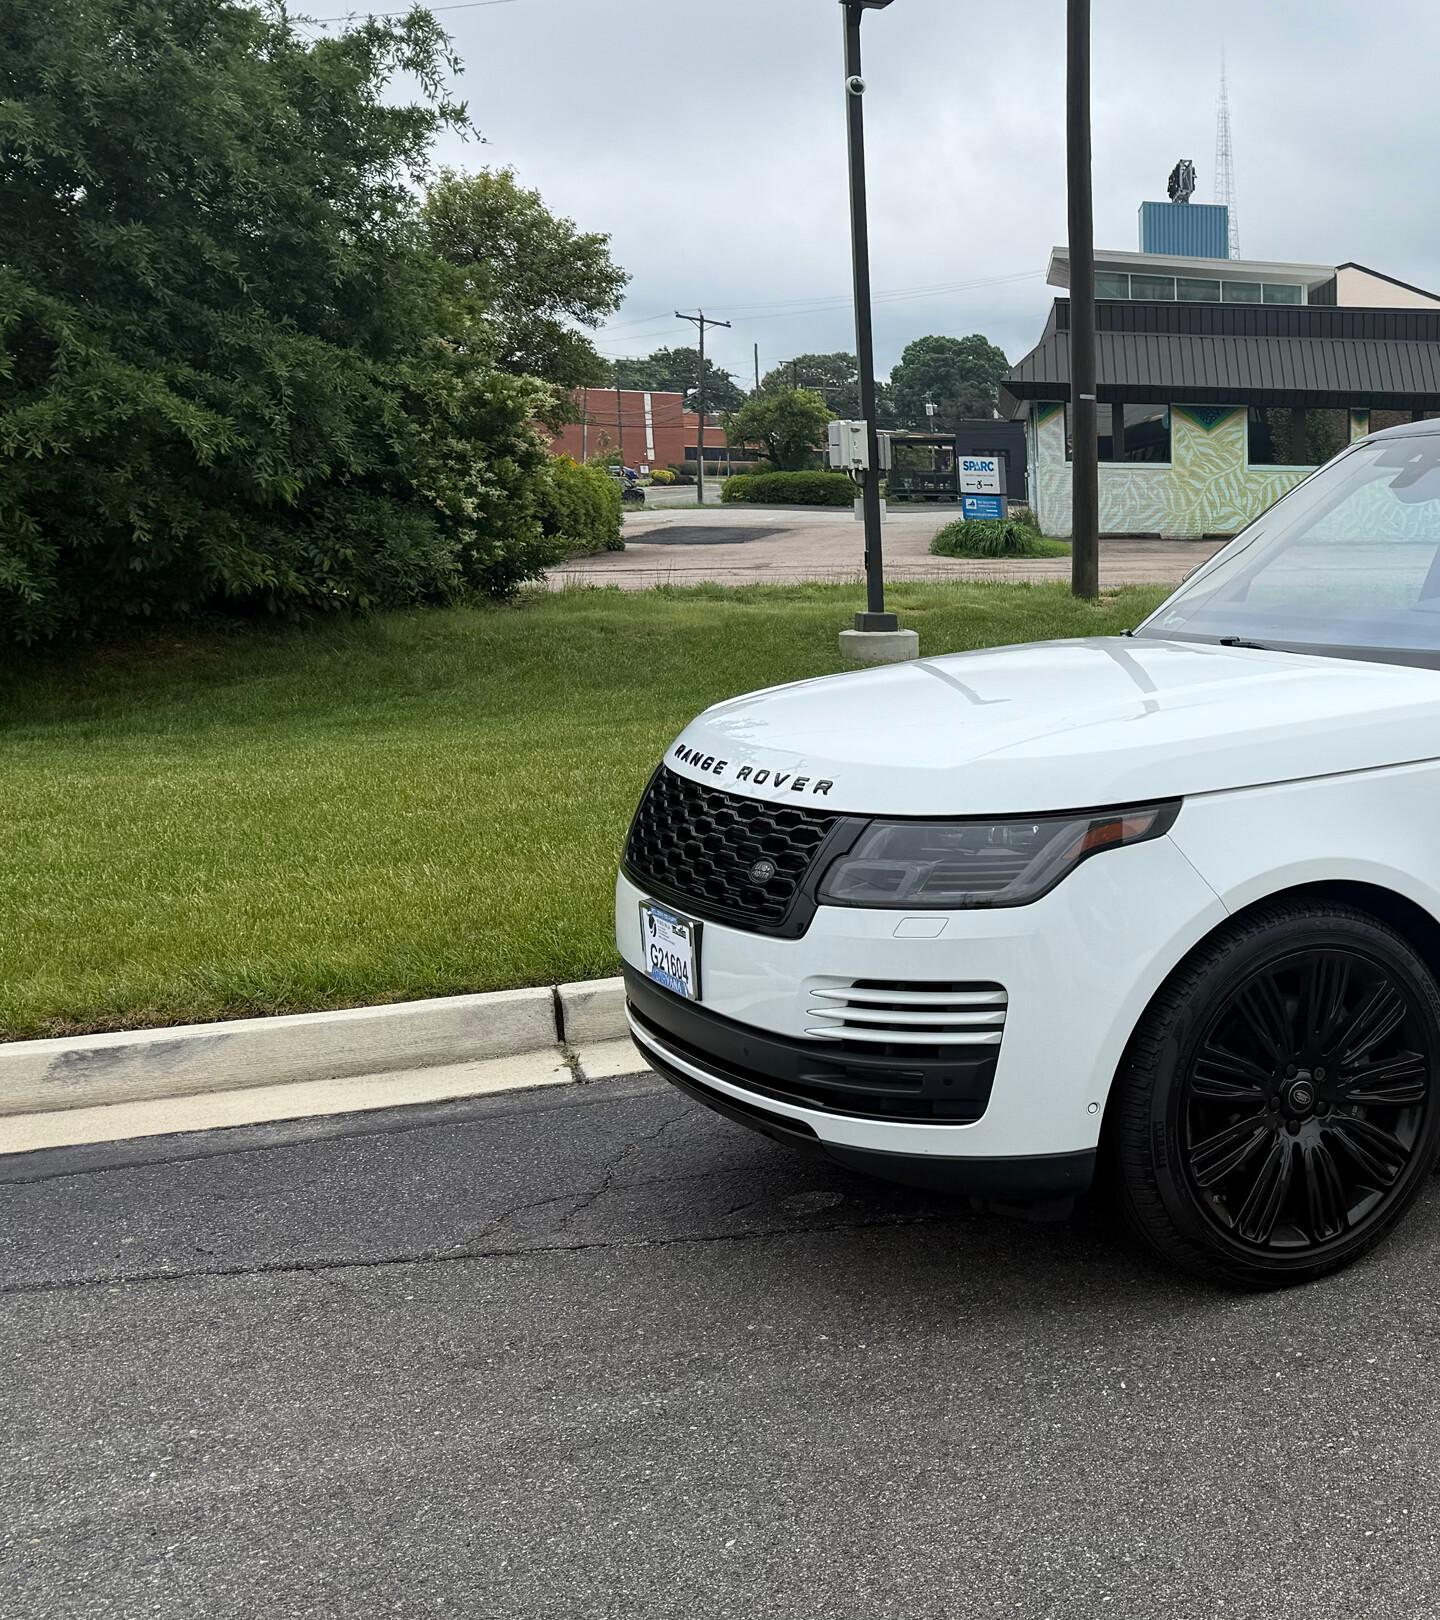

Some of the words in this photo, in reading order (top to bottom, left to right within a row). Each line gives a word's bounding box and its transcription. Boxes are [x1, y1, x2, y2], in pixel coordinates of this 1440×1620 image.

[963, 461, 994, 472] SPARC
[674, 744, 728, 776] RANGE
[736, 766, 834, 795] ROVER
[650, 944, 688, 984] G21604
